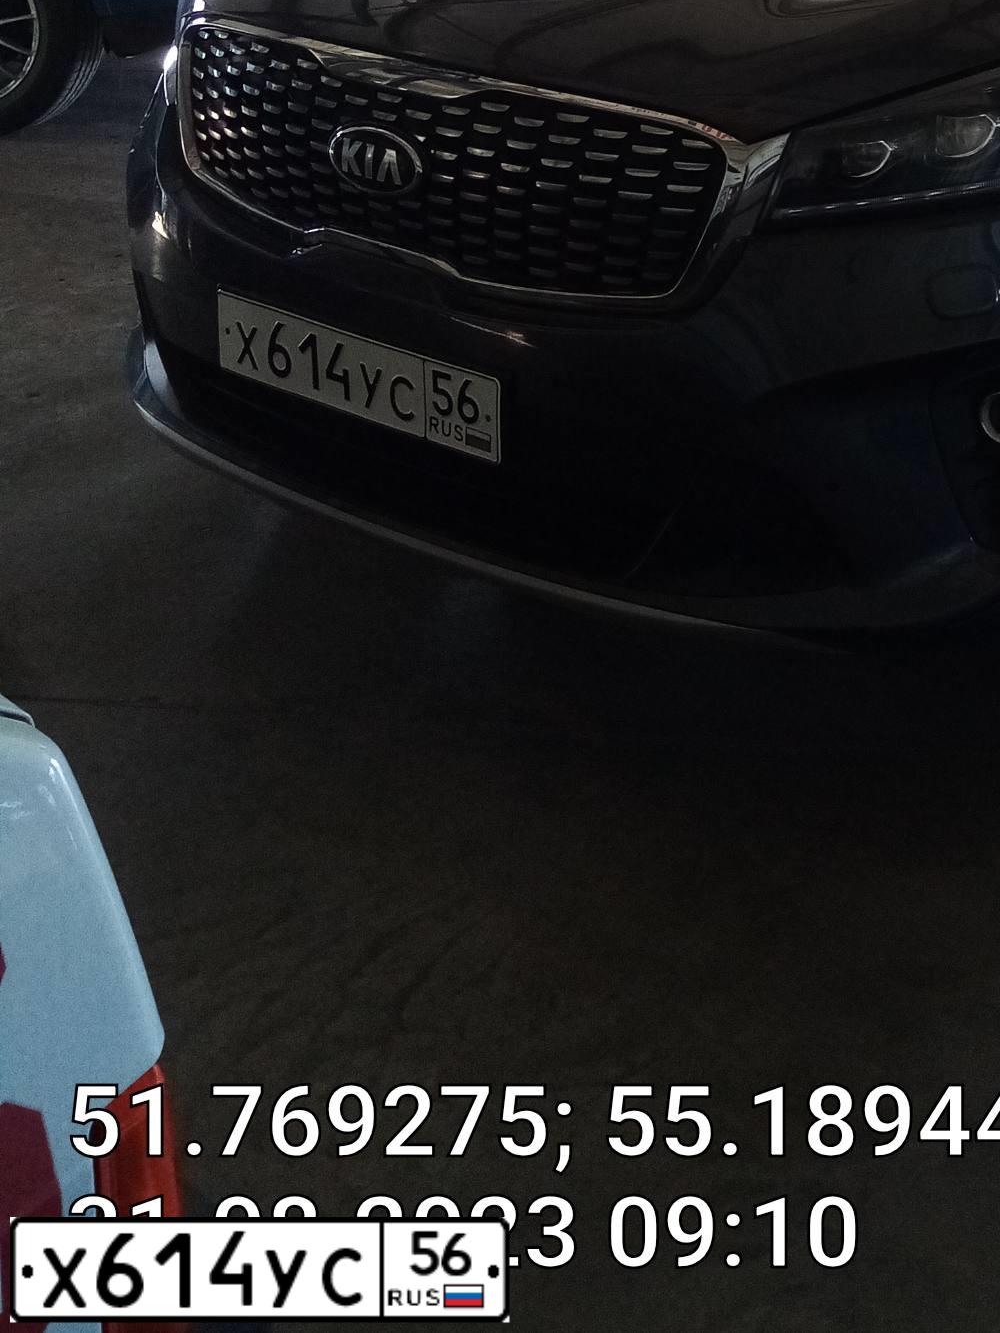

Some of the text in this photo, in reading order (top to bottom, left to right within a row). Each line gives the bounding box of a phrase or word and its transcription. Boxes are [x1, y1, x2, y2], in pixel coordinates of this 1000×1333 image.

[341, 137, 402, 185] KIA
[431, 370, 480, 424] 56
[429, 418, 464, 442] RUS
